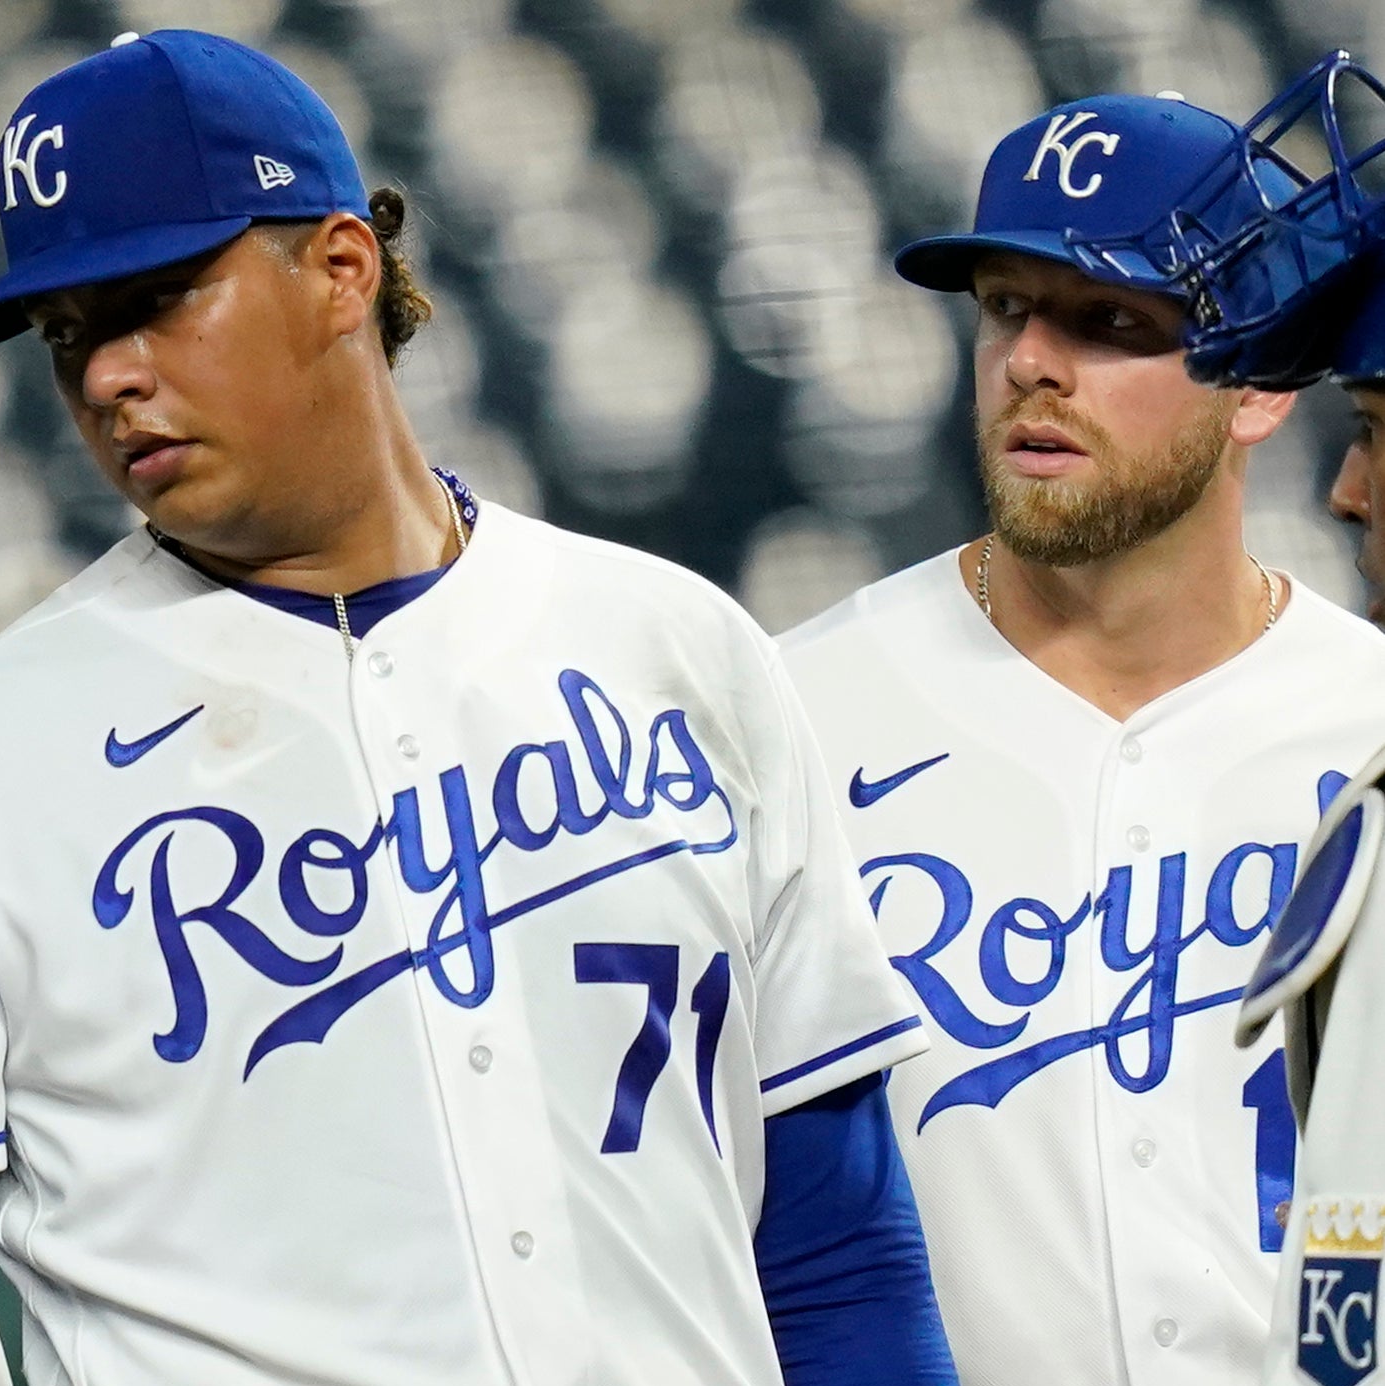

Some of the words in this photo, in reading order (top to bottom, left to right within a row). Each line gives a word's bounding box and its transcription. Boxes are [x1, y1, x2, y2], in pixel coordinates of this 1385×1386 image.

[2, 112, 68, 212] KC
[1022, 111, 1121, 199] KC
[92, 667, 738, 1064] Royals
[859, 770, 1351, 1094] Roya
[573, 941, 731, 1160] 71
[1300, 1268, 1375, 1371] KC
